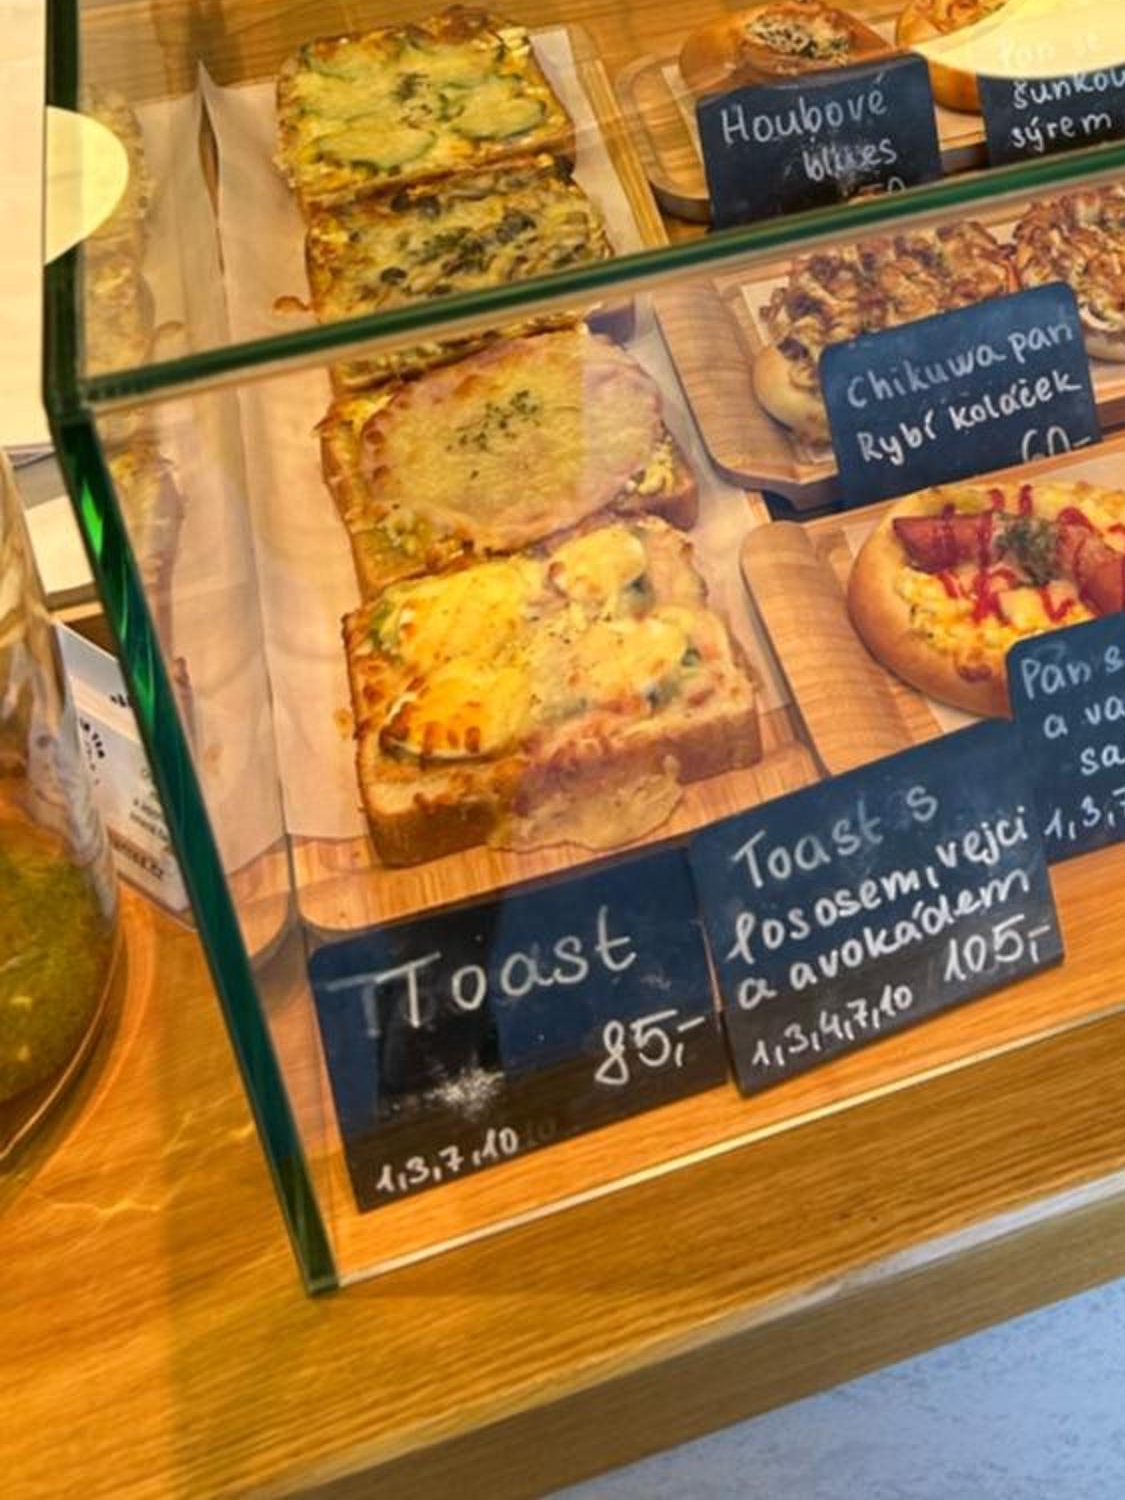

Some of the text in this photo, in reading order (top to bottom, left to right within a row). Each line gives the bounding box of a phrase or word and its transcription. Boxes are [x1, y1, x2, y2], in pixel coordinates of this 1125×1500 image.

[720, 72, 888, 145] Houbové
[1010, 111, 1112, 152] sýrem
[847, 322, 1073, 408] Chikuwa pan
[949, 369, 1082, 431] koláček
[1020, 656, 1092, 700] Pan
[1104, 645, 1125, 673] s
[1043, 713, 1069, 740] a
[731, 784, 938, 890] Toast s
[936, 806, 1029, 869] vejci
[374, 905, 638, 1030] Toast
[738, 867, 1030, 1011] a avokádem
[942, 912, 1052, 983] 105,-
[594, 1008, 706, 1087] 85,-
